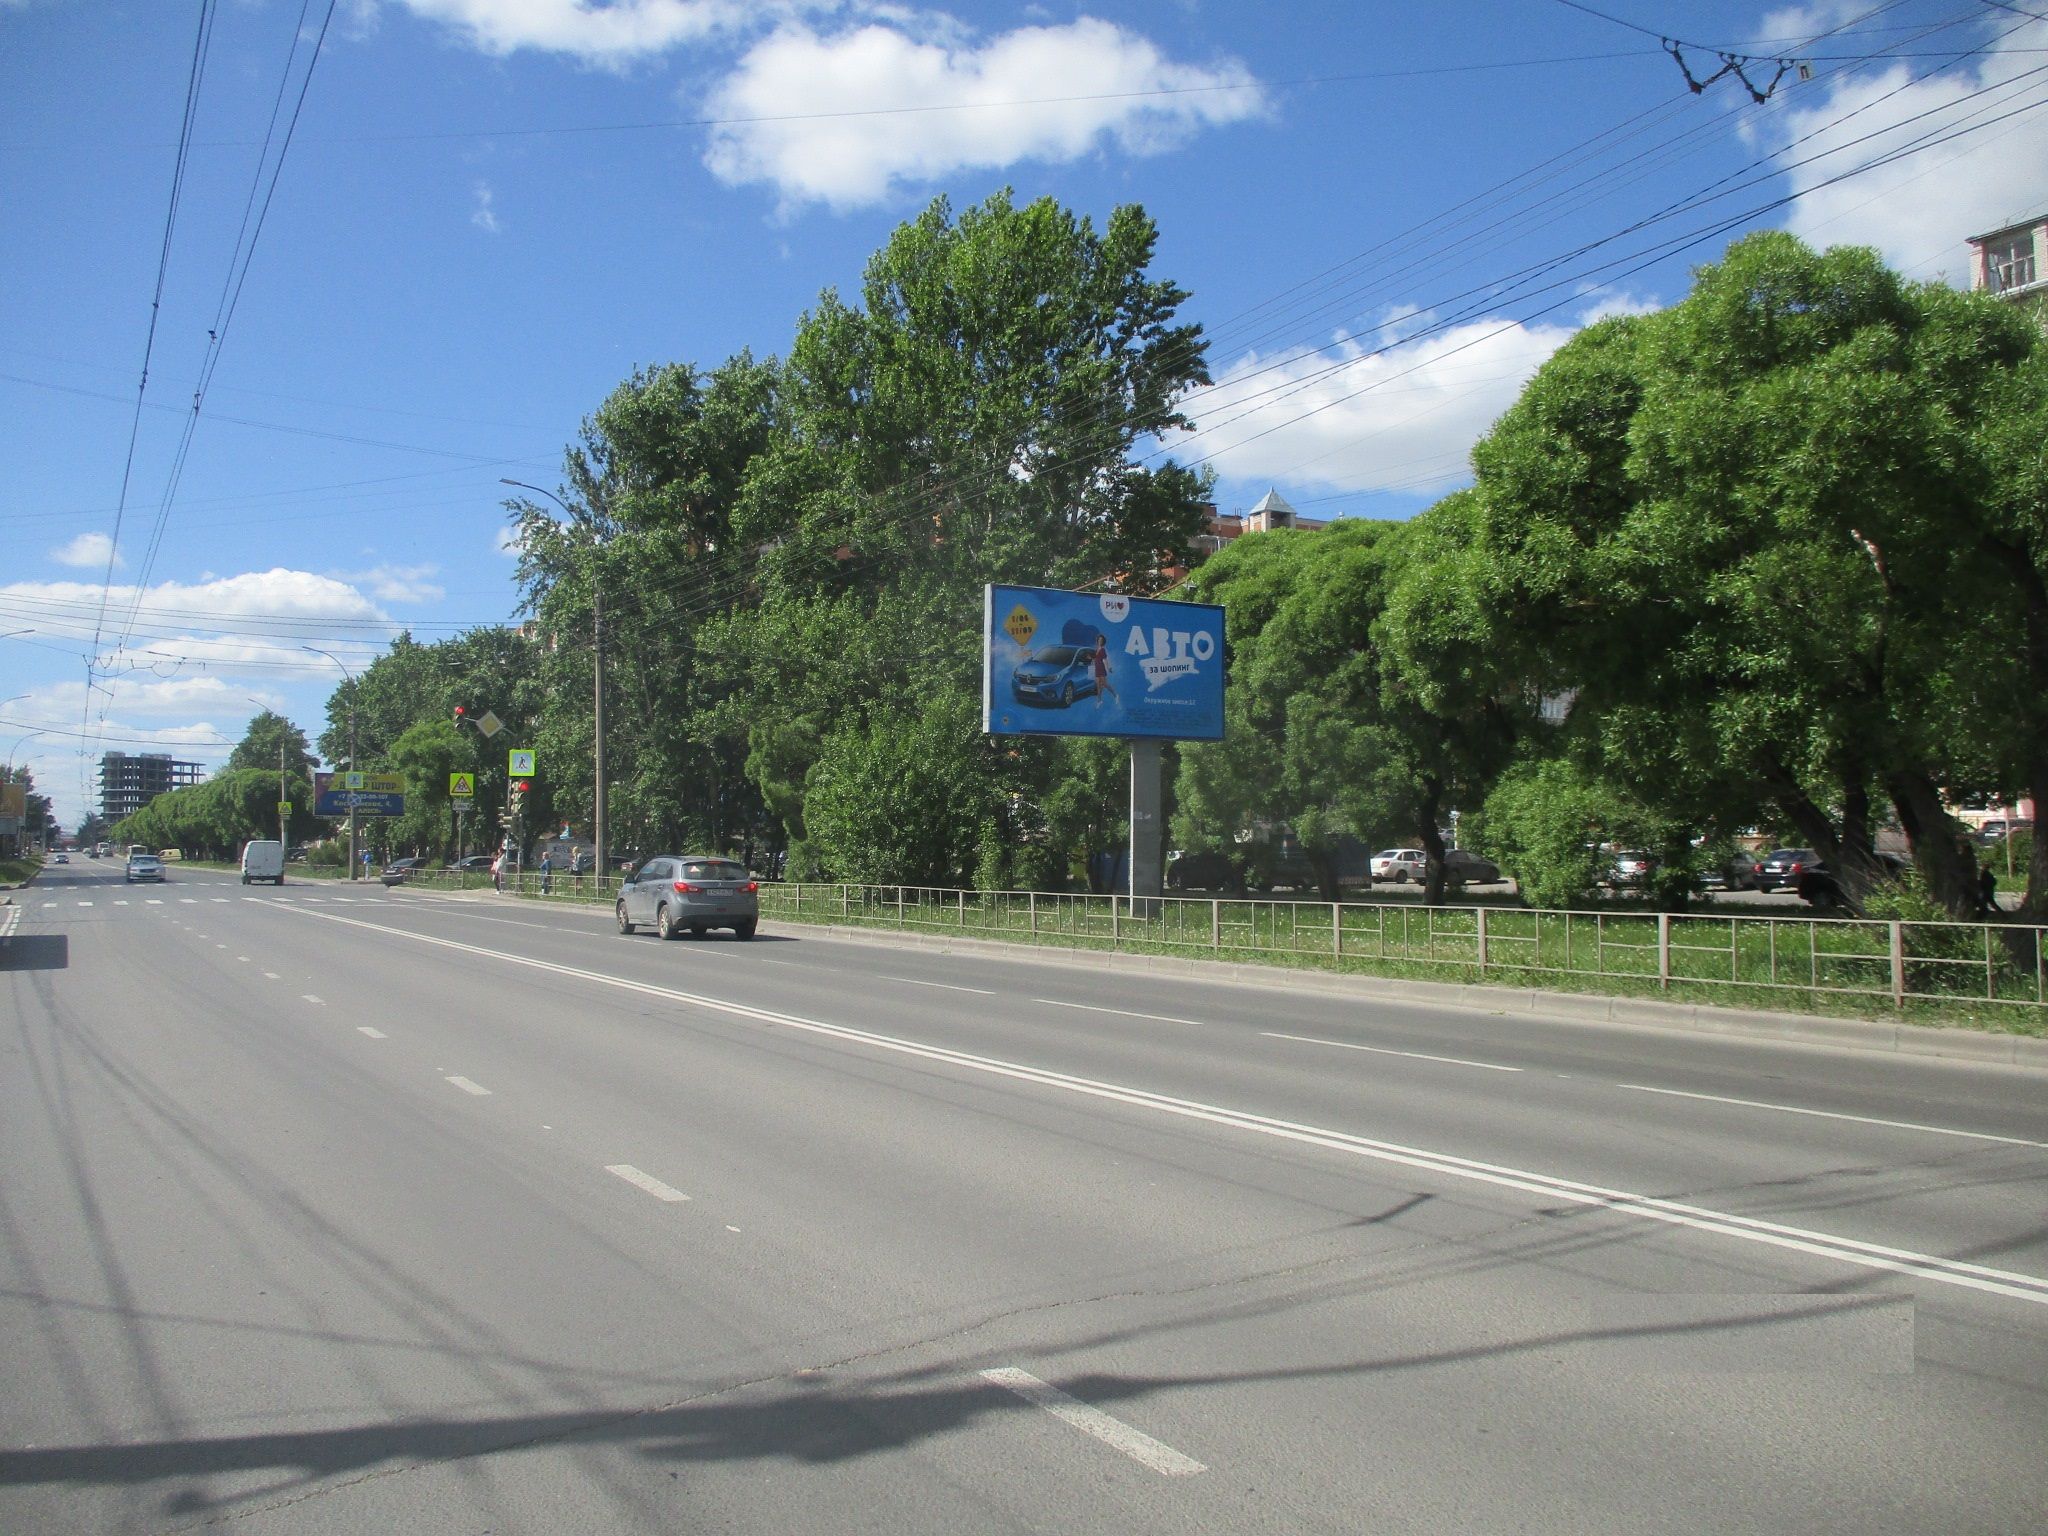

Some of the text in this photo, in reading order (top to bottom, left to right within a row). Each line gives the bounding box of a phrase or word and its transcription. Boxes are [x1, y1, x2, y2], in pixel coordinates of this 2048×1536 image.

[1124, 625, 1215, 661] АВТО
[1149, 664, 1190, 674] за шопинг
